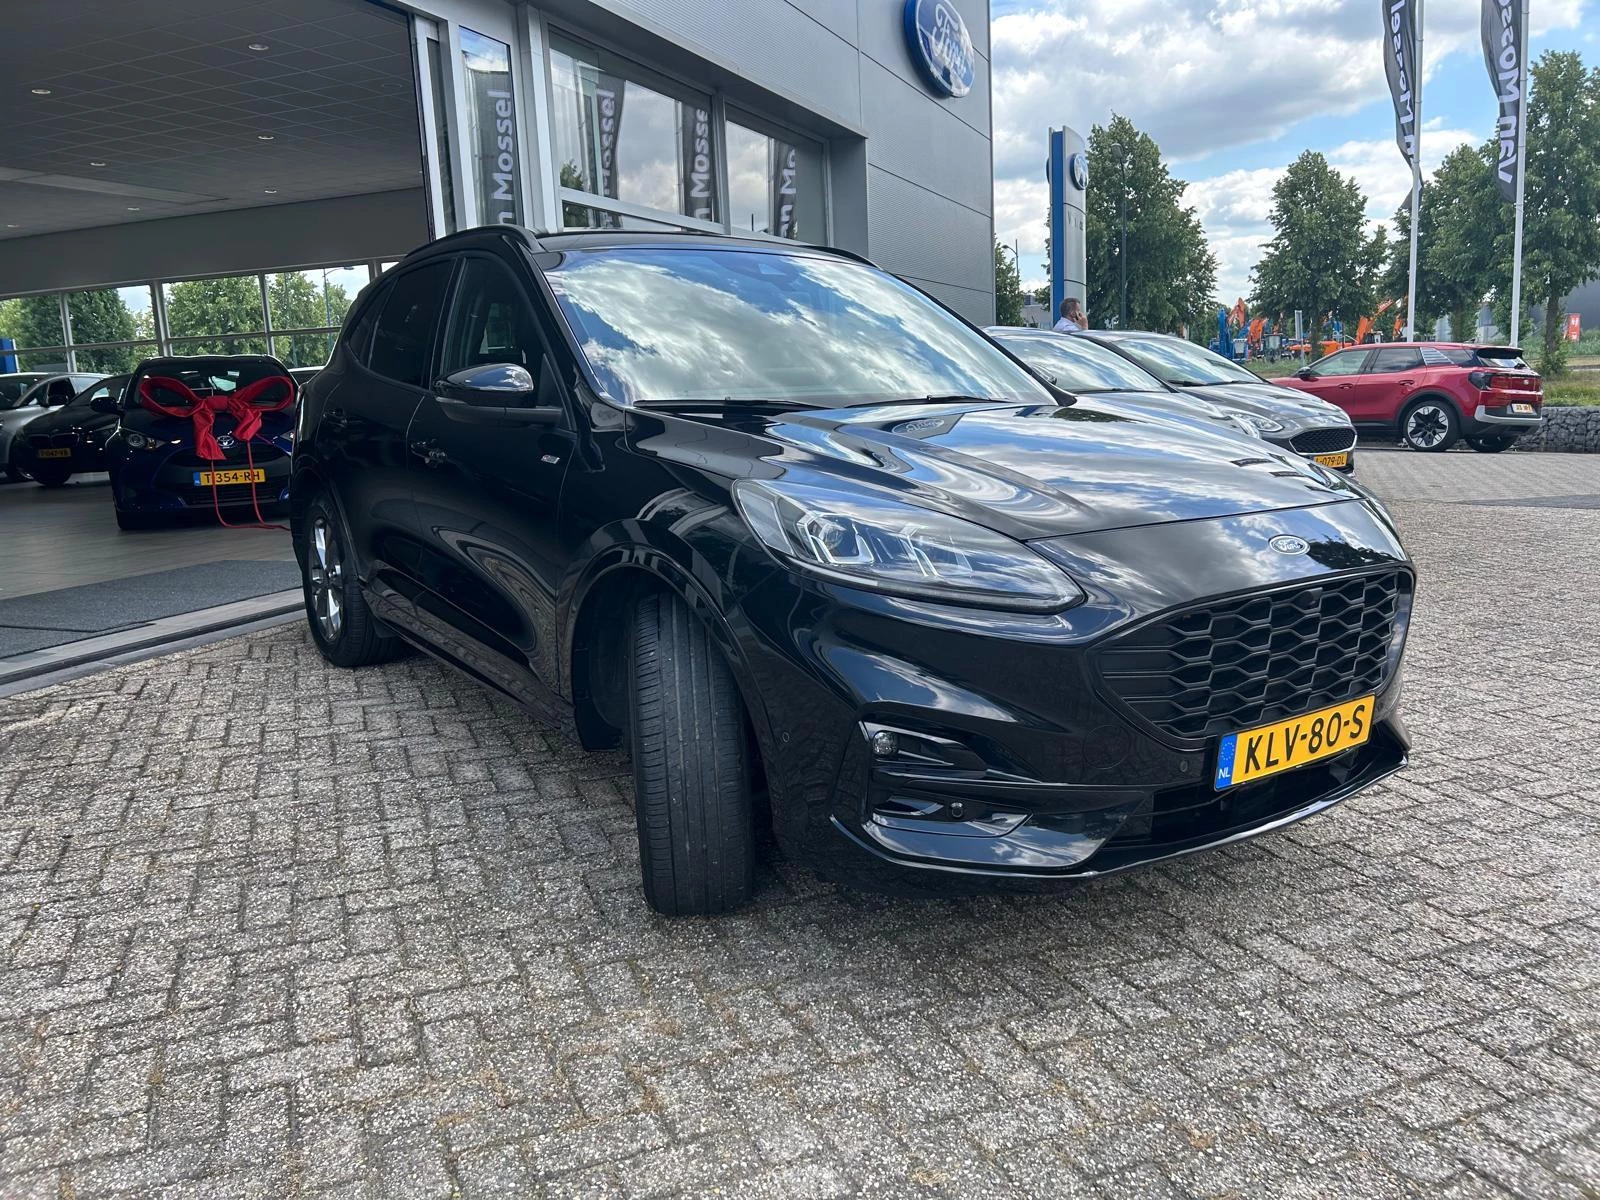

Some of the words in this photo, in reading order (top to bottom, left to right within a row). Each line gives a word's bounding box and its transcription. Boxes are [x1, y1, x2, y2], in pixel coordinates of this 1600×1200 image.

[931, 3, 967, 77] Ford
[487, 90, 514, 201] Mossel
[690, 108, 711, 198] Mosse
[203, 470, 260, 484] T354-RH
[1218, 768, 1230, 779] NL
[1244, 703, 1366, 774] KLV-80-S
